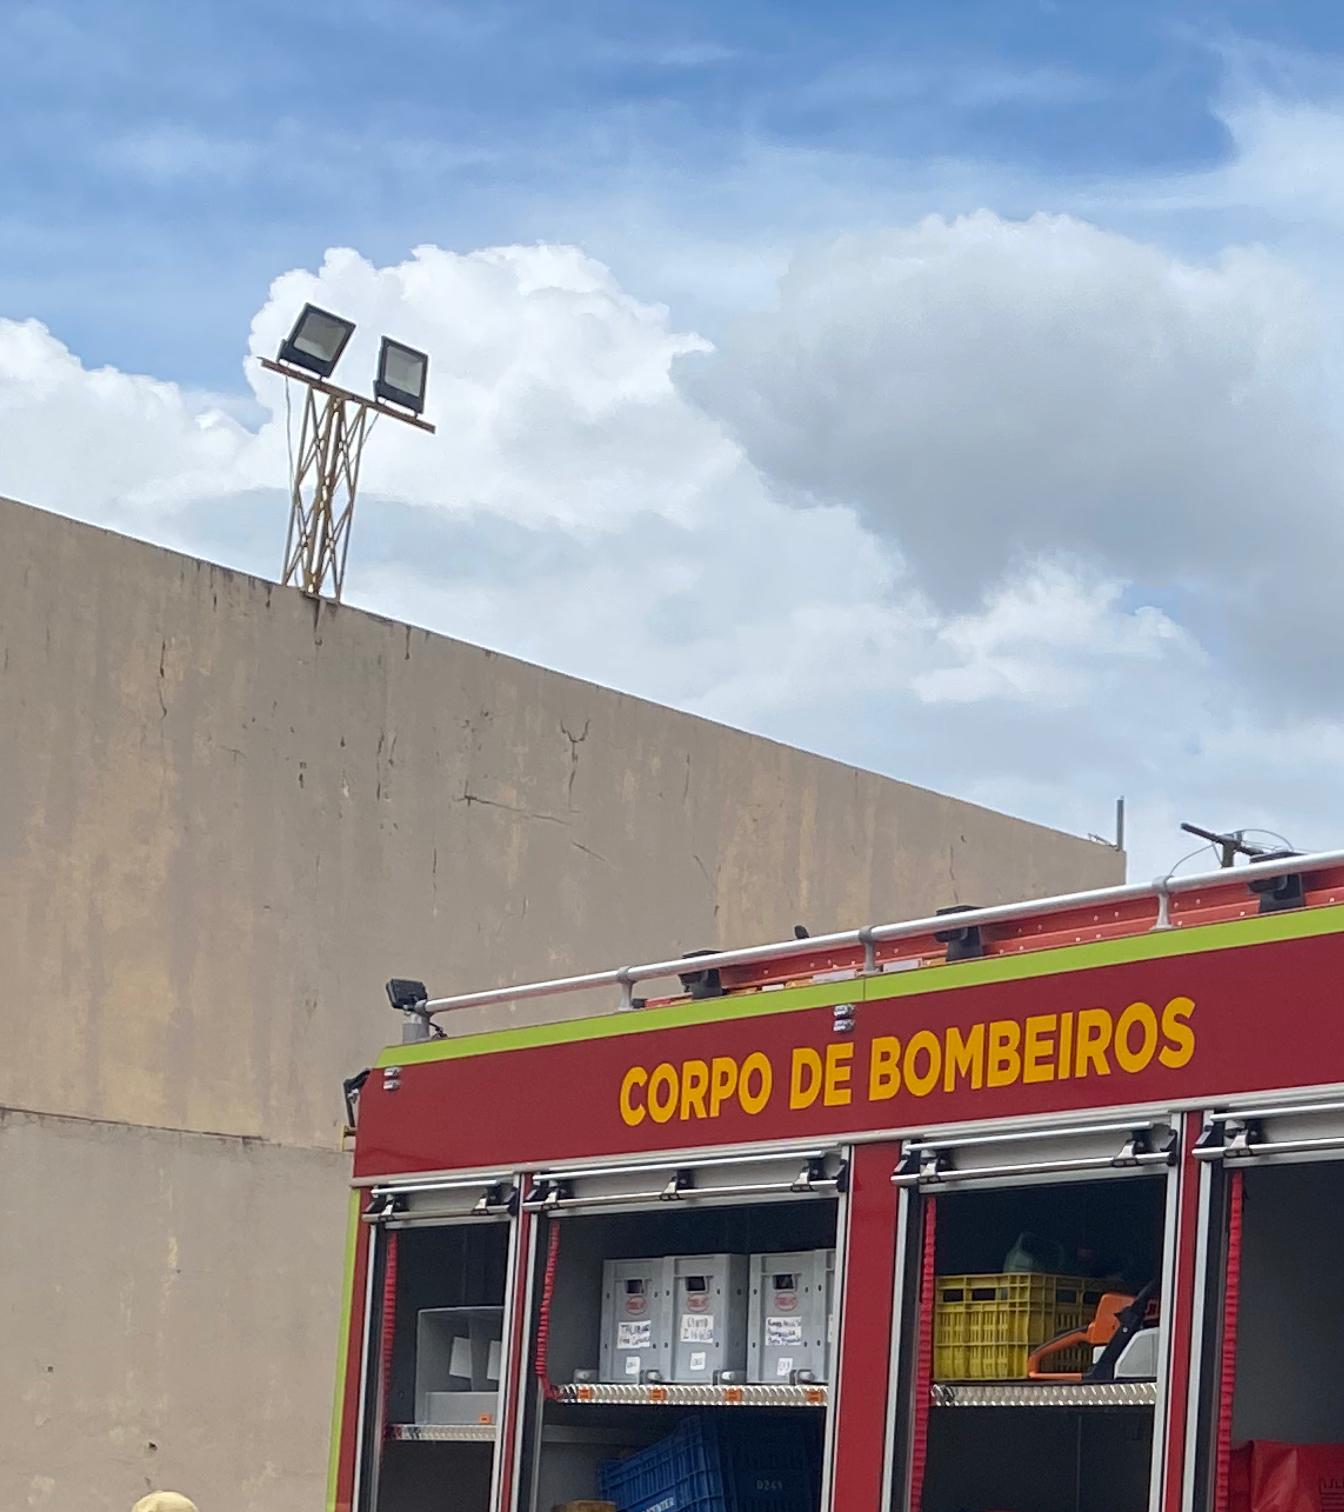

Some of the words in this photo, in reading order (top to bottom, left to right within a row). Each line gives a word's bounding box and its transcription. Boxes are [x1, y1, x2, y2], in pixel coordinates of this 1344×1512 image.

[620, 1052, 772, 1126] CORPO
[790, 1044, 855, 1111] DE
[868, 996, 1196, 1102] BOMBEIROS
